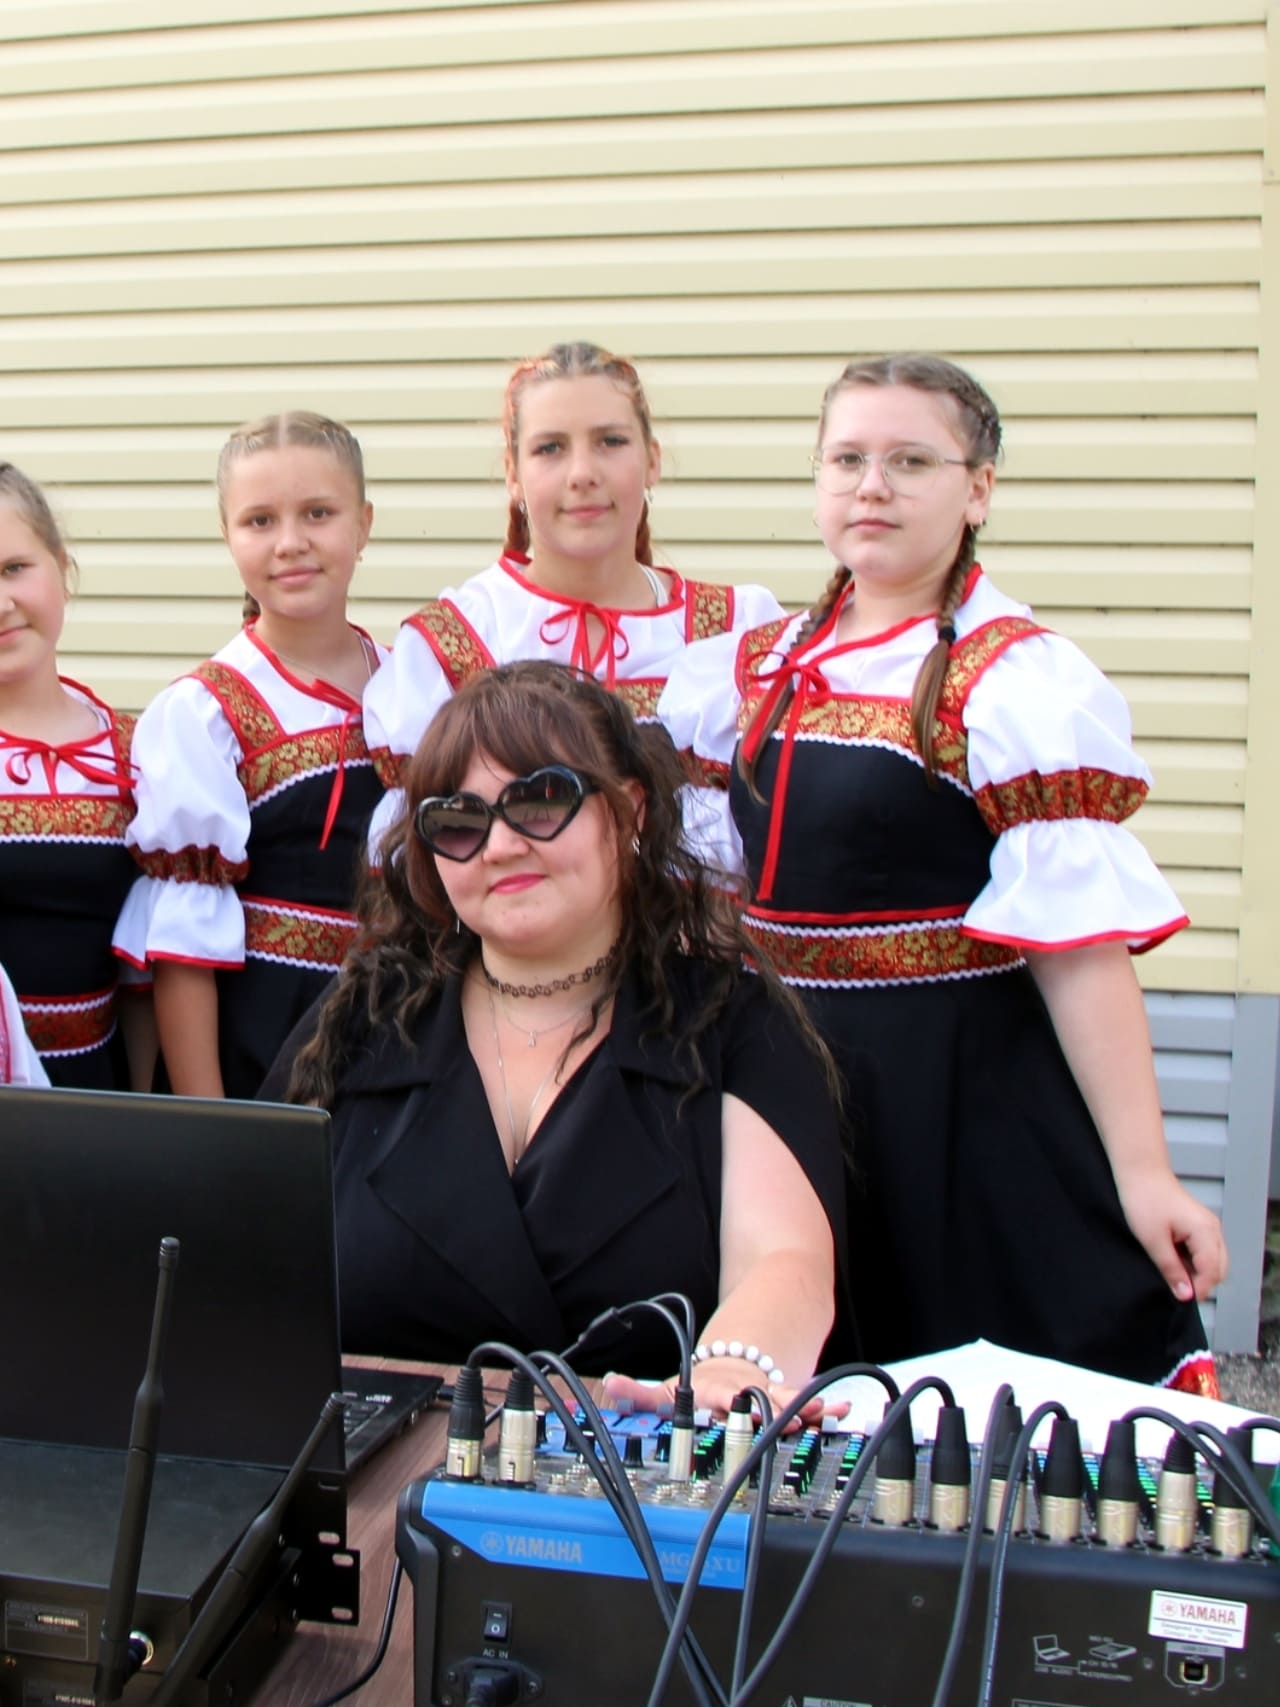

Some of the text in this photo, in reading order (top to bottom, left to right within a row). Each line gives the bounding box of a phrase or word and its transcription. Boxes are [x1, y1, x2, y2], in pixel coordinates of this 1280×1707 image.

[505, 1535, 583, 1564] YAMAHA
[1180, 1603, 1236, 1625] YAMAHA
[482, 1648, 495, 1657] AC
